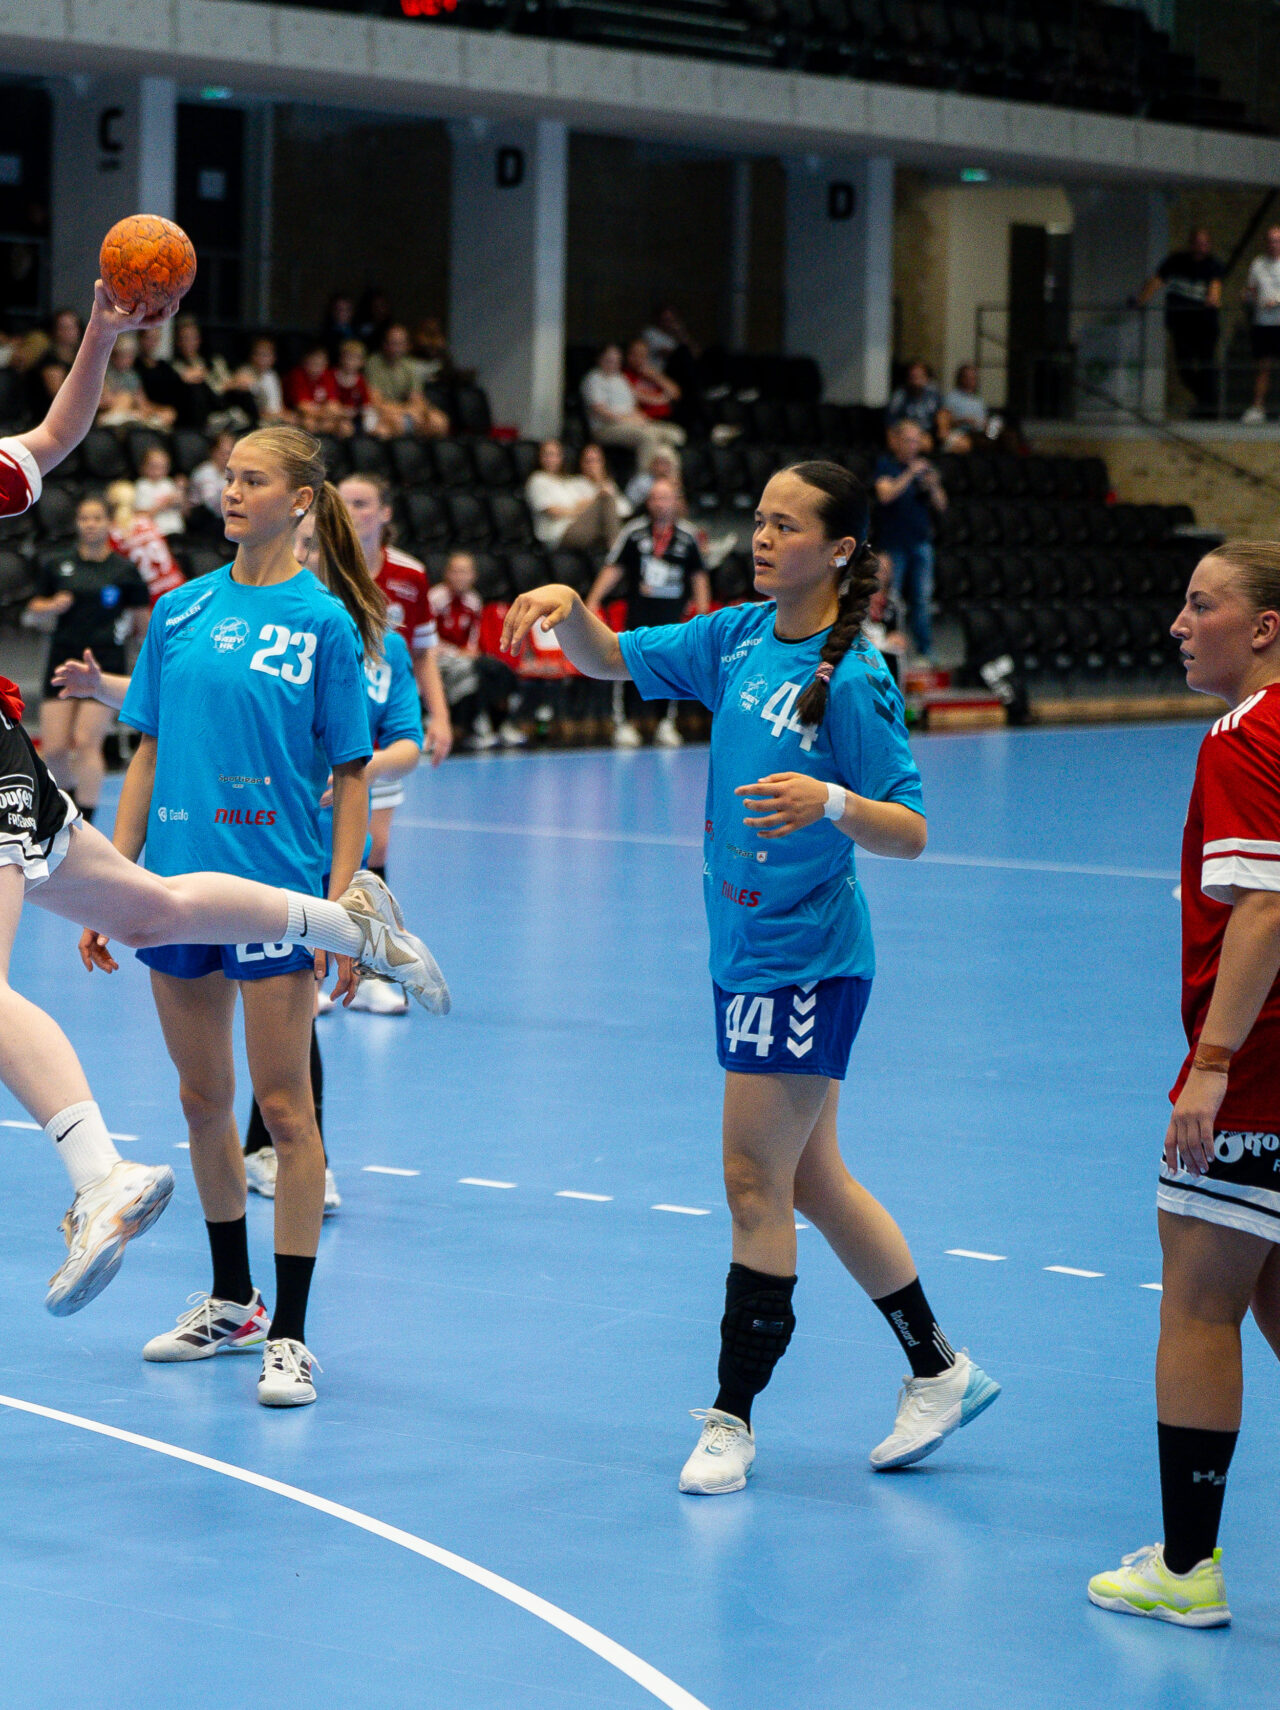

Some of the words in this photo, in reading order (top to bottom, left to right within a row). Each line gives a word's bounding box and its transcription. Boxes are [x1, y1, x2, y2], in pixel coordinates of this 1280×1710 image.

[100, 108, 125, 151] C
[497, 147, 525, 188] D
[829, 183, 854, 219] D
[249, 623, 317, 685] 23
[761, 681, 818, 752] 44
[726, 994, 774, 1057] 44
